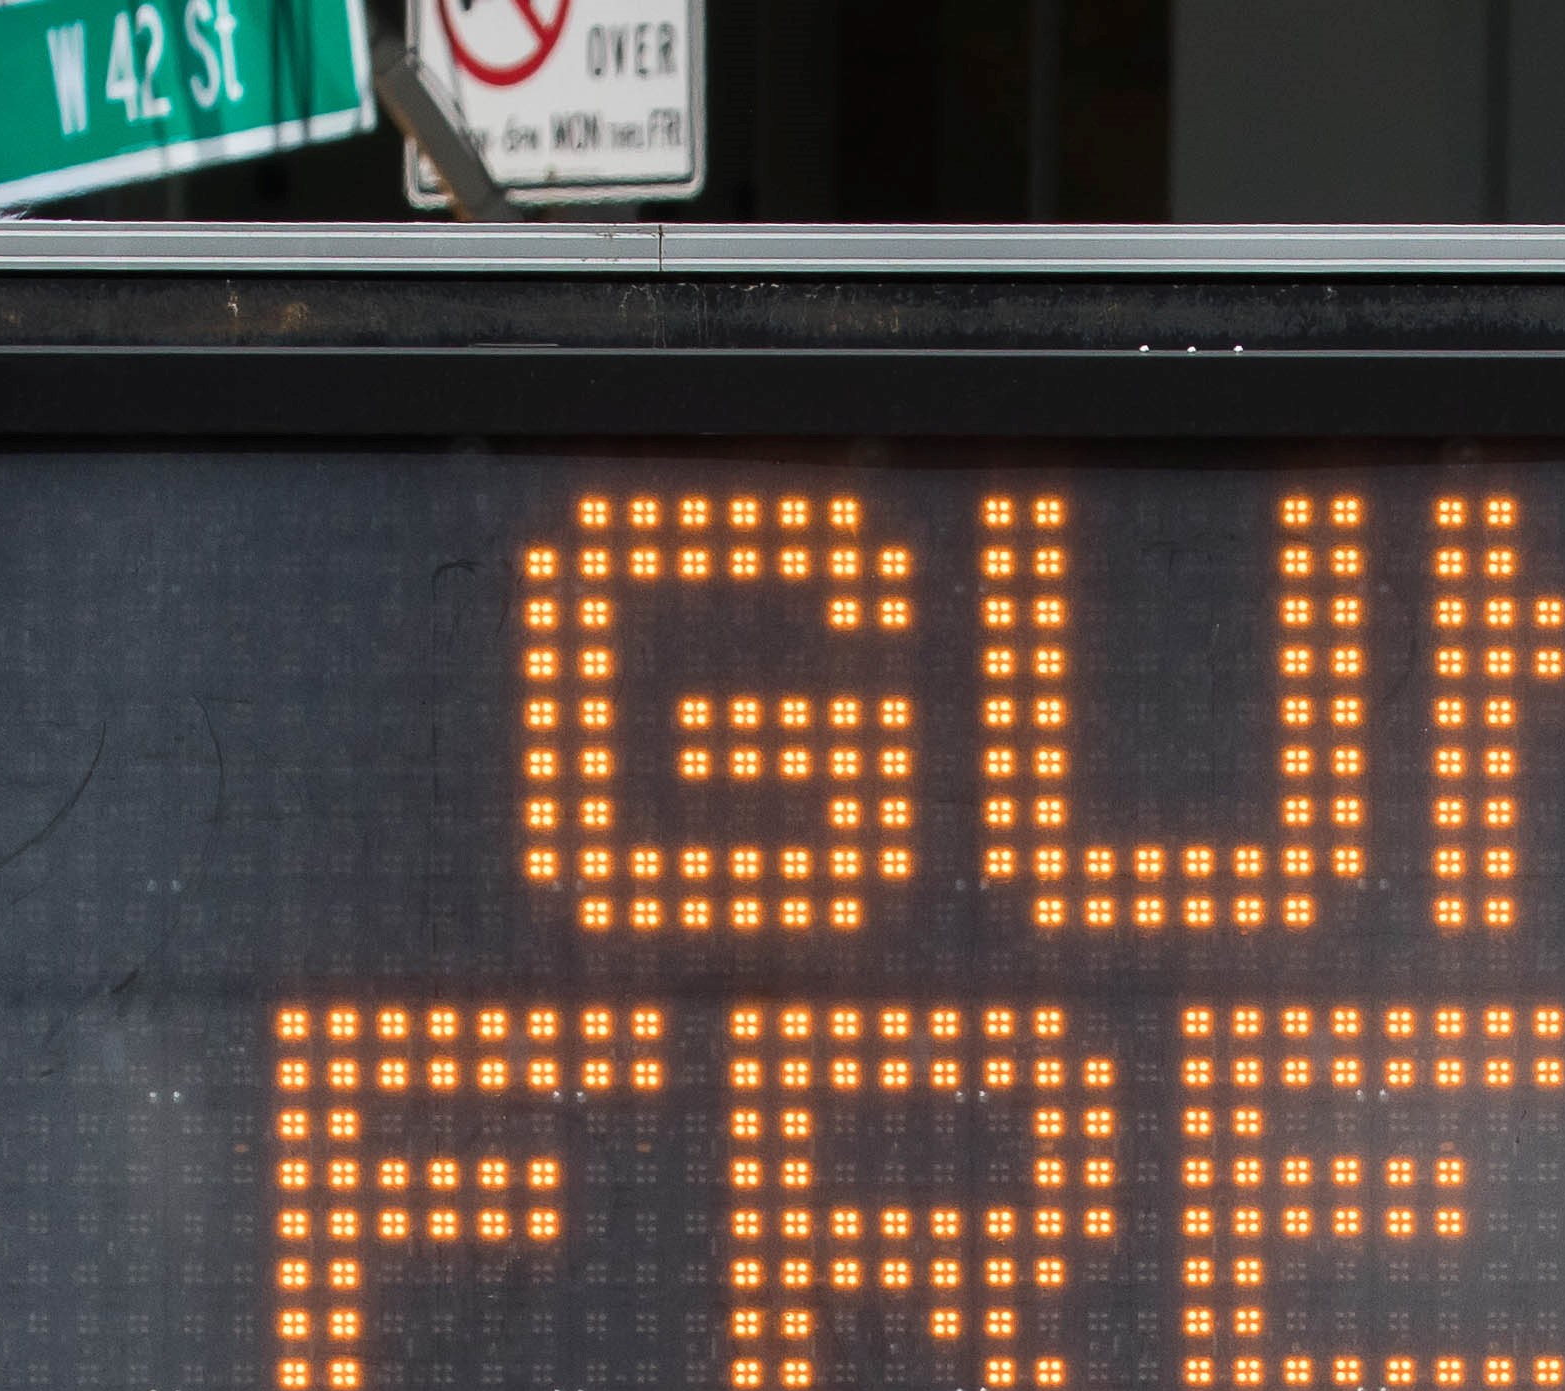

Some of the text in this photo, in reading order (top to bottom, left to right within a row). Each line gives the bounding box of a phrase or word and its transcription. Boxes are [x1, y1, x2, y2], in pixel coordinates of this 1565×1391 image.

[47, 0, 243, 136] W 42 St
[587, 23, 677, 75] OVER
